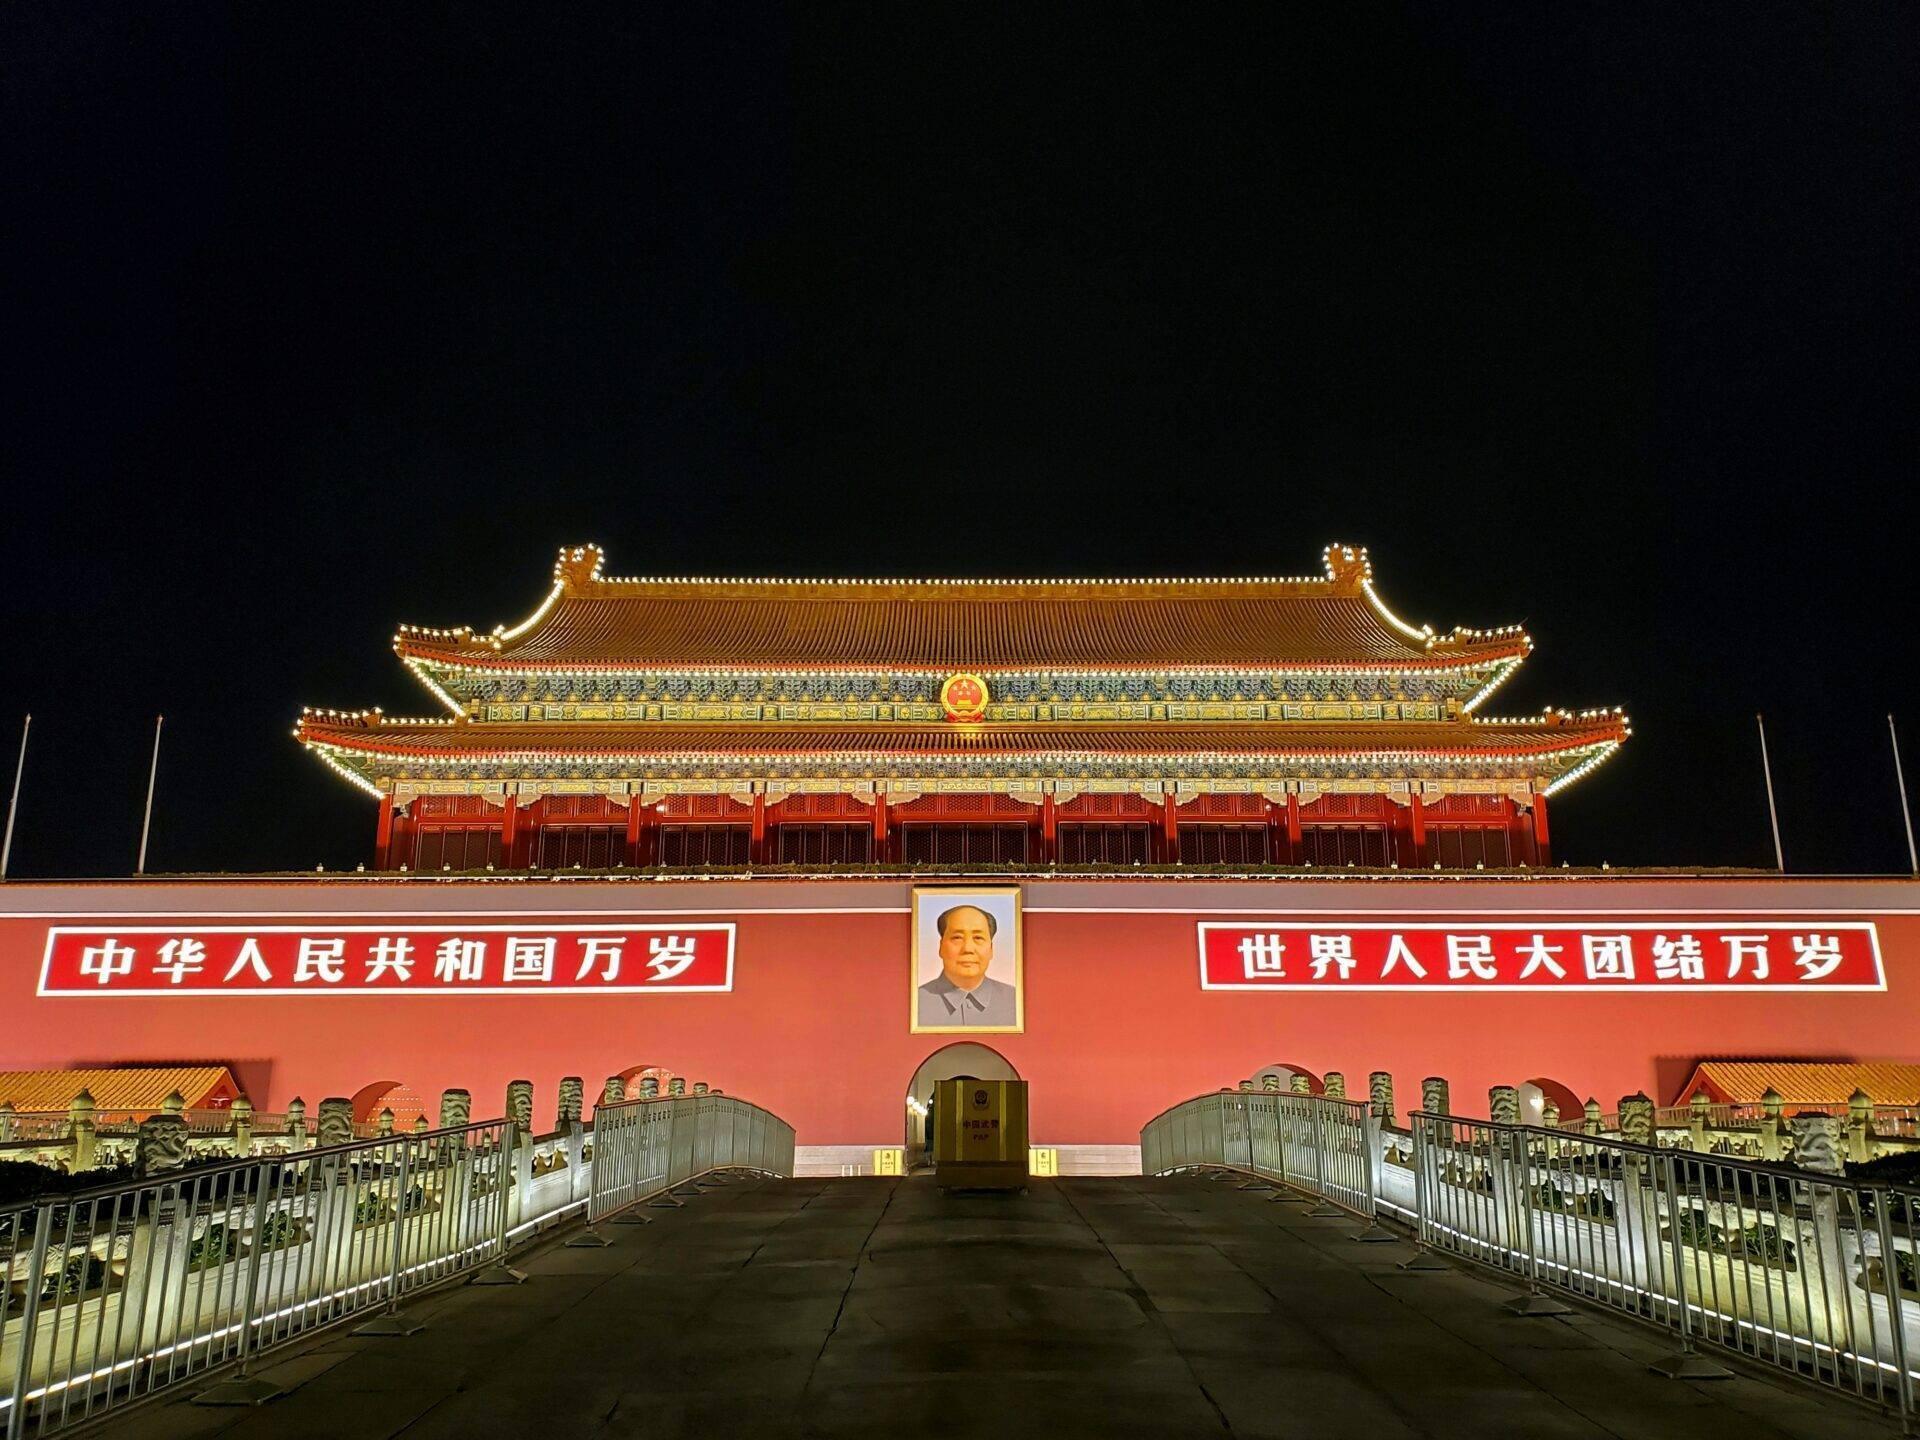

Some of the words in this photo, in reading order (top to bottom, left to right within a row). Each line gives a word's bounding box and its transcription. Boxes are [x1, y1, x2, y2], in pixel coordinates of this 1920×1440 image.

[80, 936, 696, 984] 中华人民共和国万岁
[1237, 934, 1843, 980] 世界人民大团结万岁
